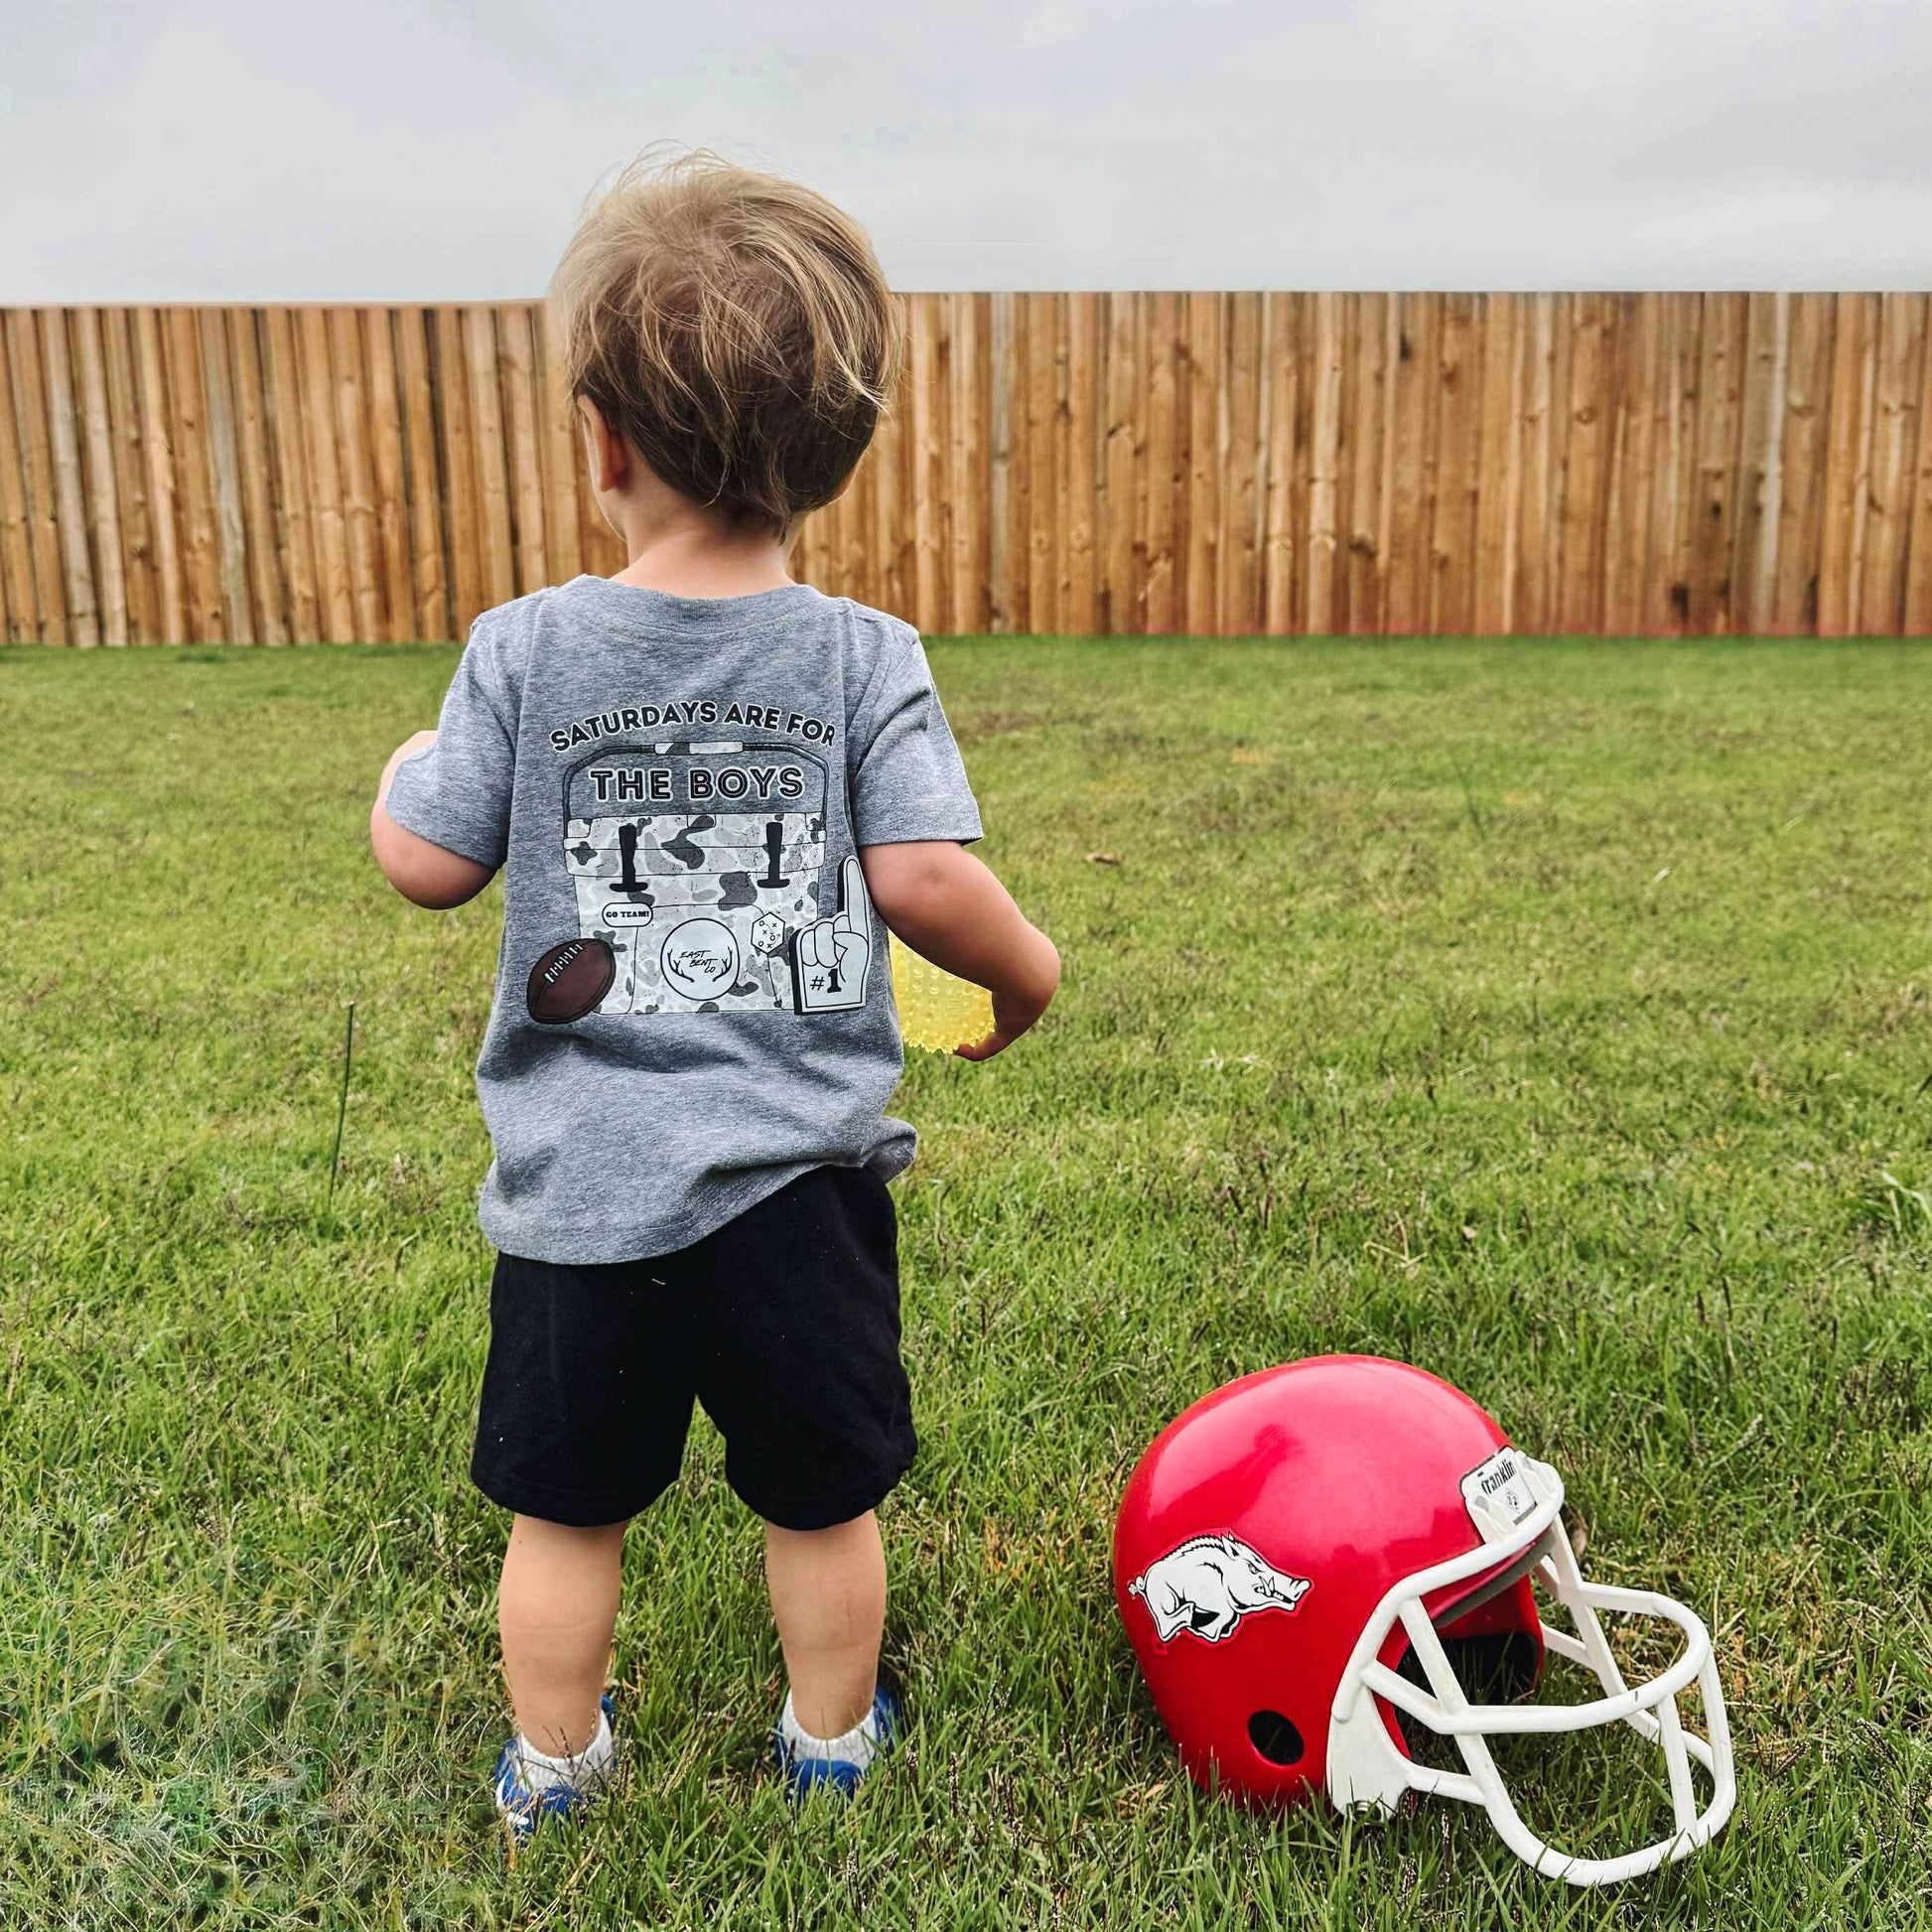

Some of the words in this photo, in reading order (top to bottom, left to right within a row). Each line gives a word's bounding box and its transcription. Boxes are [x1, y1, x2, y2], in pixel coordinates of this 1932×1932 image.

[550, 701, 716, 753] SATURDAYS
[724, 702, 781, 731] ARE
[785, 712, 836, 747] FOR
[590, 767, 673, 801] THE
[688, 765, 804, 801] BOYS
[679, 950, 711, 959] EAST
[689, 959, 718, 968] BENT
[810, 968, 842, 994] #1
